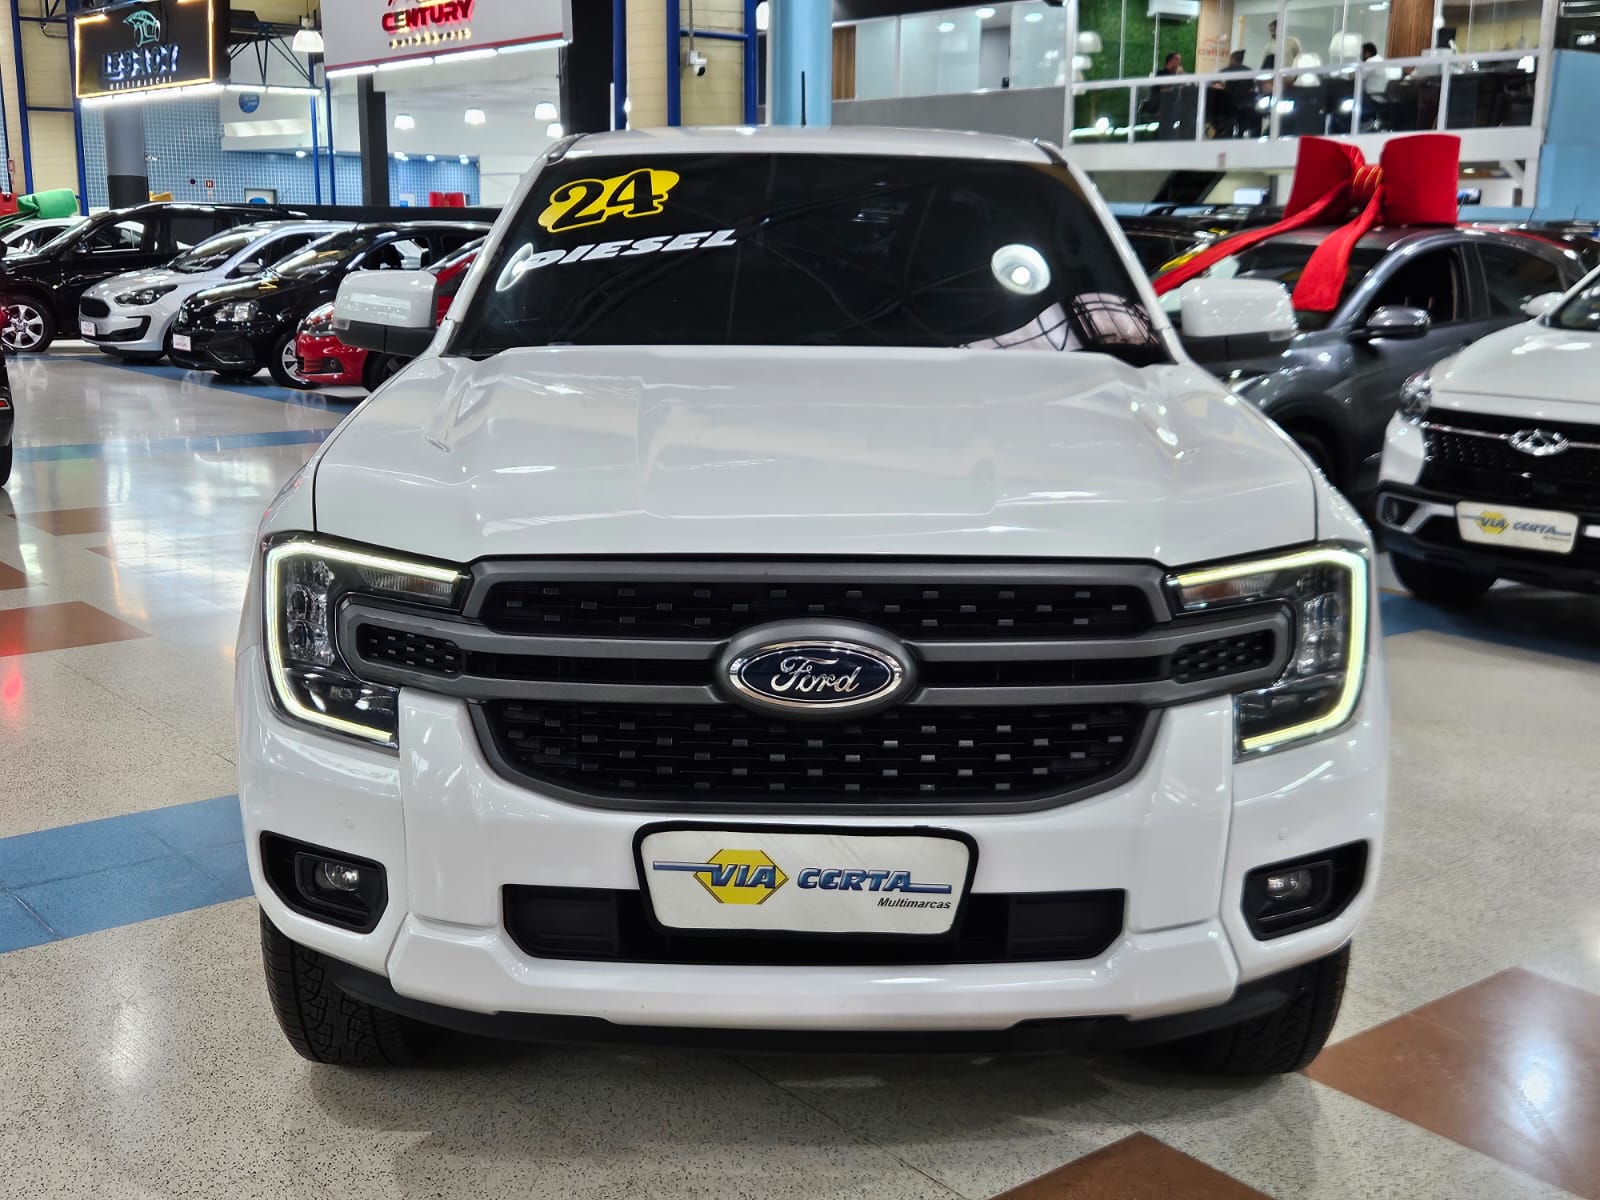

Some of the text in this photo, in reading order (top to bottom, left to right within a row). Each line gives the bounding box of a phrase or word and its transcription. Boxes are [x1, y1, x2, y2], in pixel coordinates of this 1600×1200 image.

[382, 0, 474, 32] CENTURY
[549, 168, 669, 232] 24
[522, 229, 738, 271] DIESEL
[771, 655, 862, 693] Ford
[708, 863, 913, 892] VIA CERTA
[876, 897, 952, 910] Multimarcas
